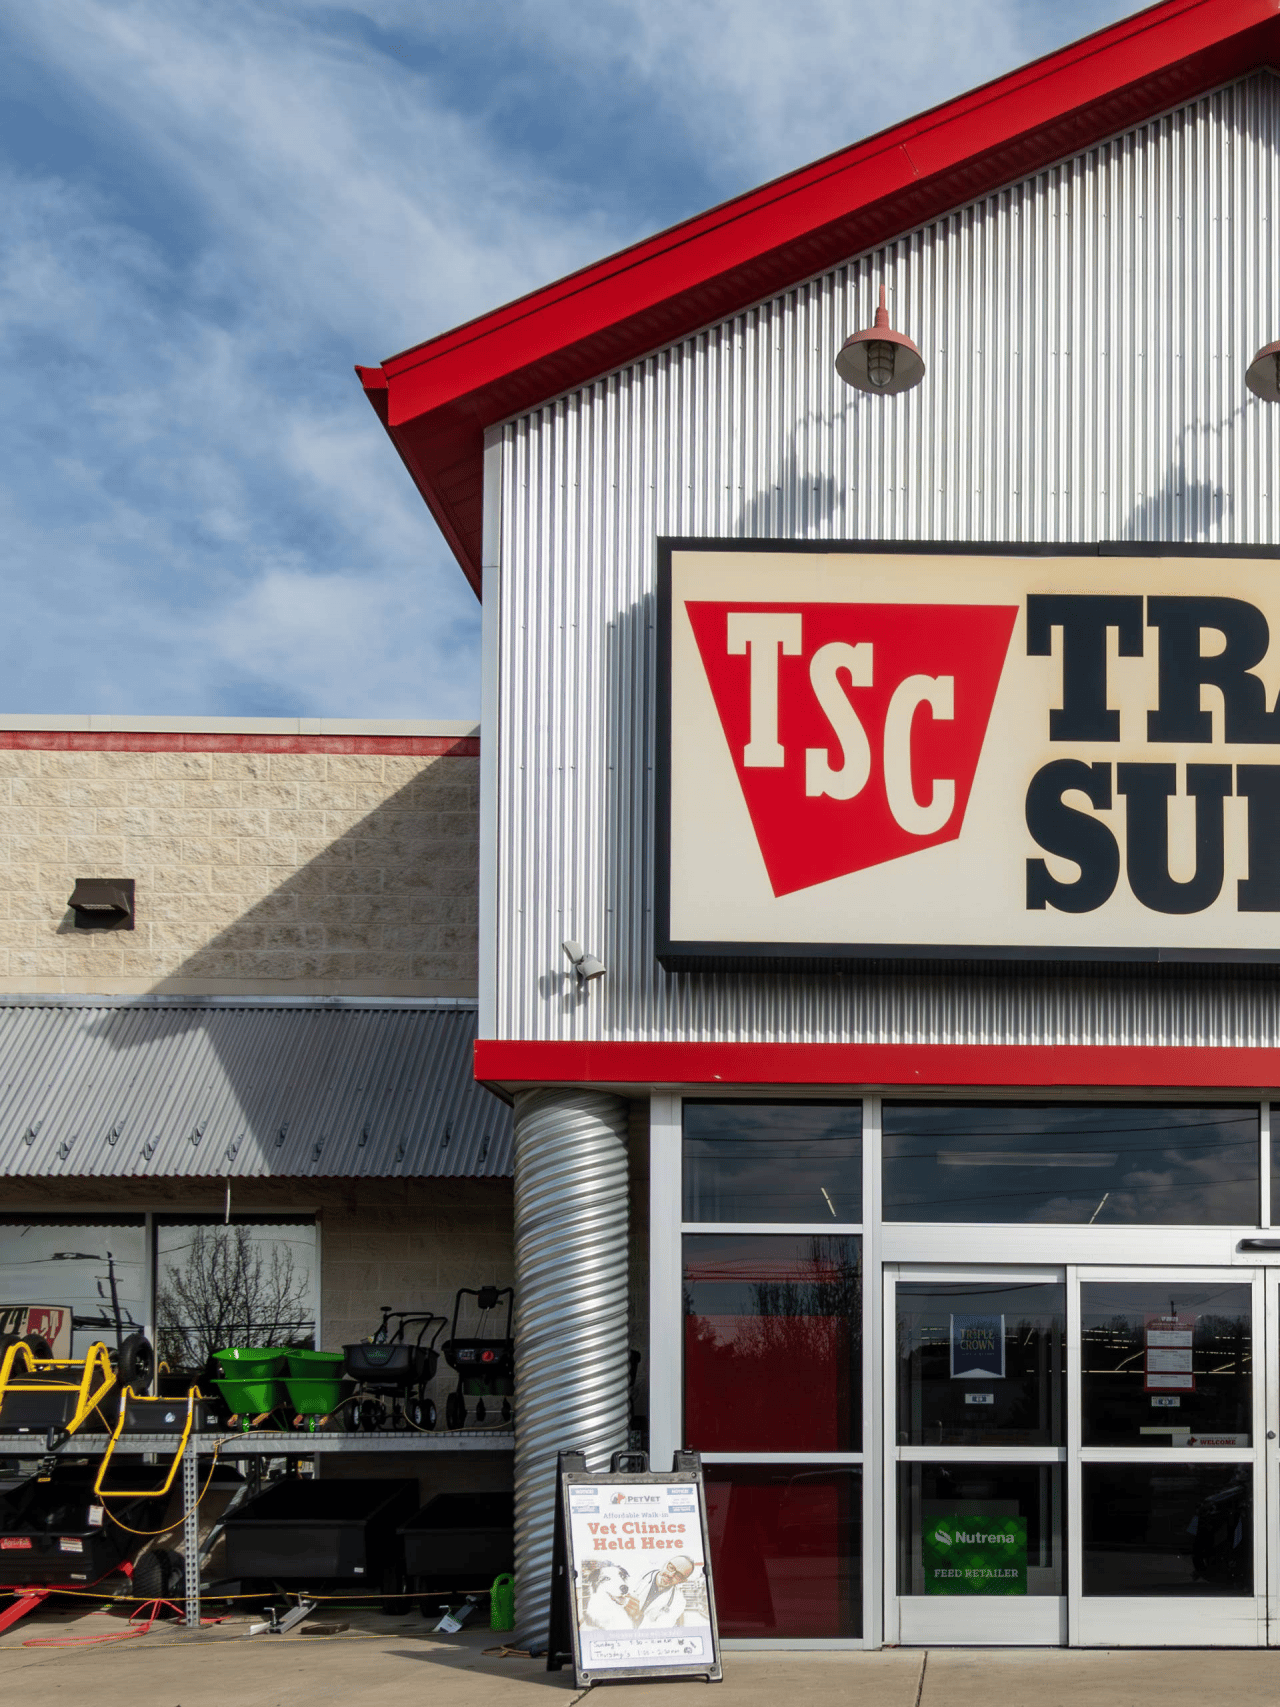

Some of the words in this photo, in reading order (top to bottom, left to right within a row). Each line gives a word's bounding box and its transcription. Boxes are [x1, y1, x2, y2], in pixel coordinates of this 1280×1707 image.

[727, 612, 955, 836] TSC
[959, 1328, 995, 1340] TRIPLE
[959, 1339, 995, 1350] CROWN
[603, 1511, 640, 1519] Affordable
[587, 1522, 617, 1535] Vet
[621, 1521, 687, 1534] Clinics
[955, 1530, 1015, 1543] Nutrena
[592, 1537, 636, 1550] Held
[640, 1536, 684, 1549] Here
[934, 1569, 963, 1577] FEED
[964, 1569, 1019, 1577] RETAILER
